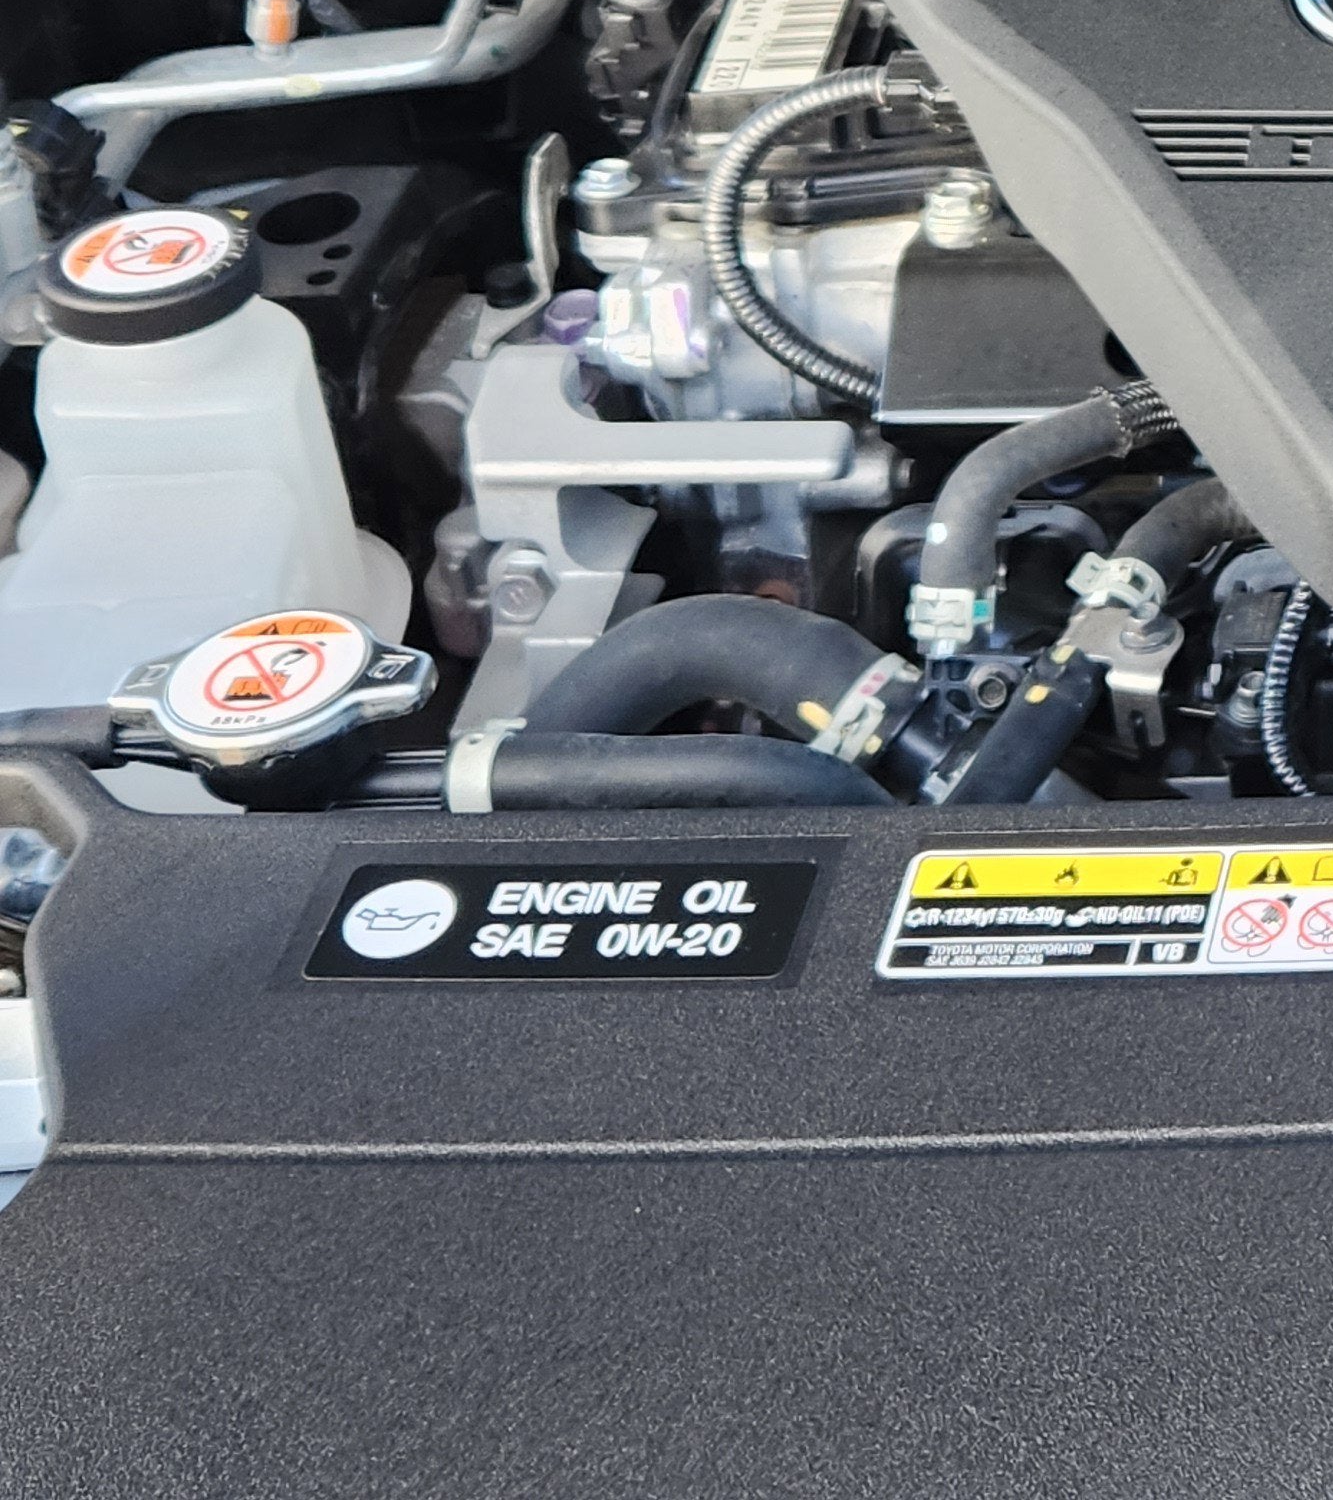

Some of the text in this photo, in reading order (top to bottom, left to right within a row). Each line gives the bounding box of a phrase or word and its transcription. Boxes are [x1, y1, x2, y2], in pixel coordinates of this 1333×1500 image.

[486, 879, 757, 915] ENGINE OIL
[470, 922, 743, 958] SAE 0W-20
[930, 943, 1094, 956] TOYOTA MOTOR CORPORATION
